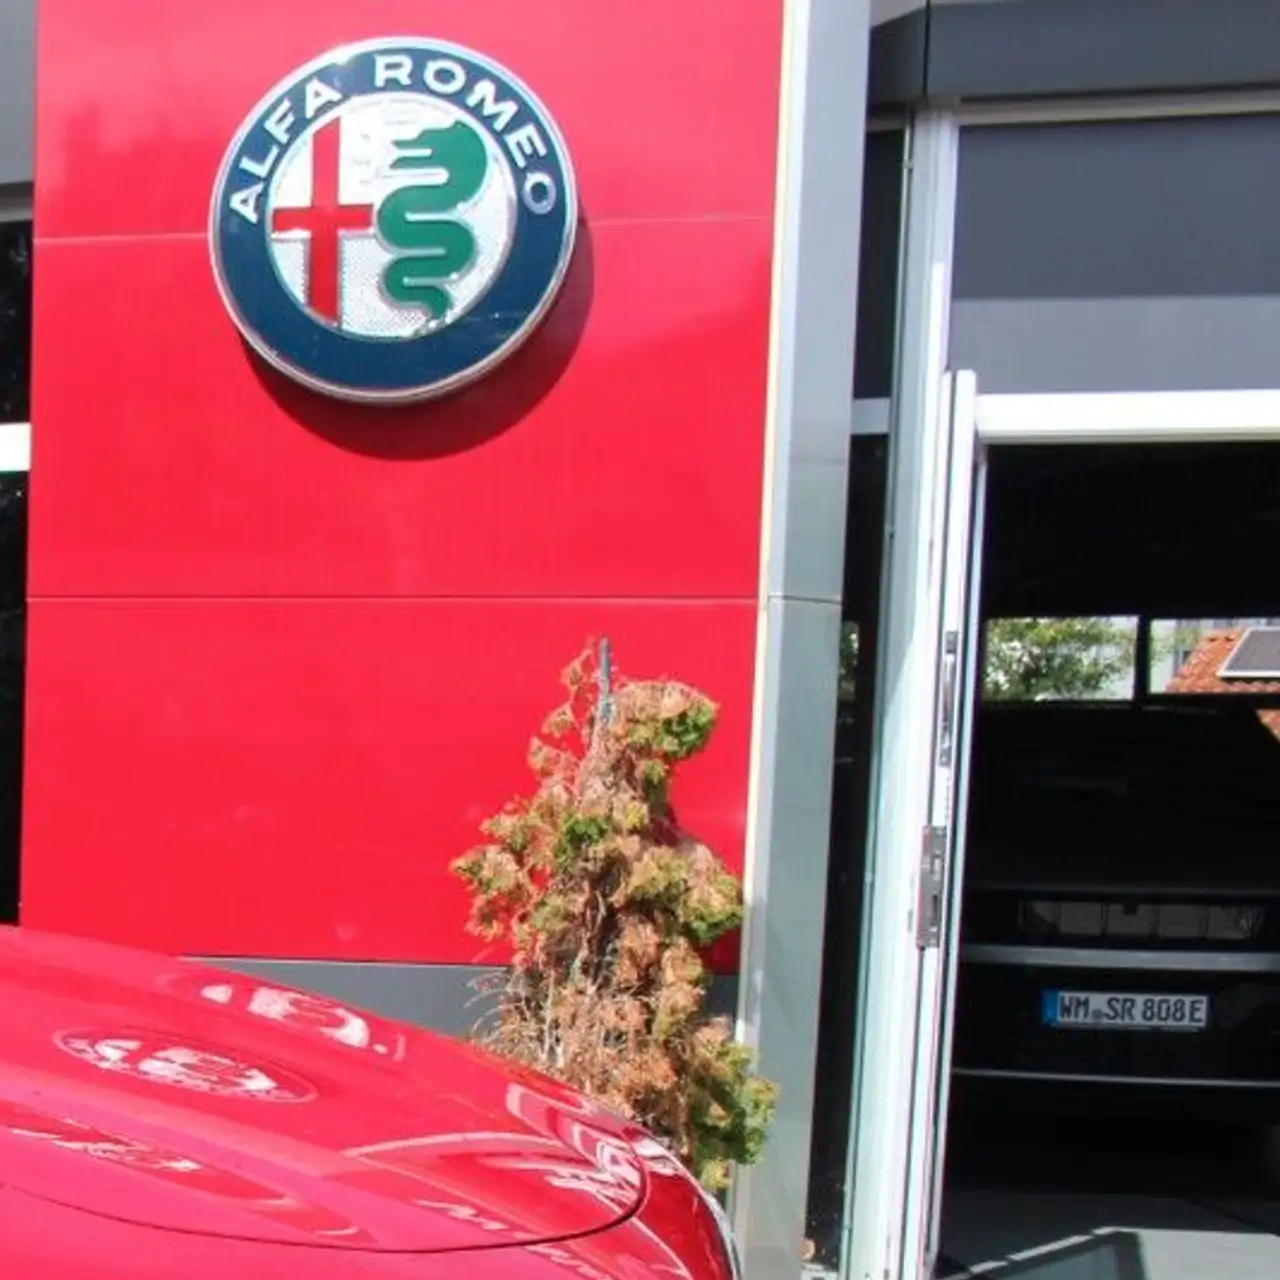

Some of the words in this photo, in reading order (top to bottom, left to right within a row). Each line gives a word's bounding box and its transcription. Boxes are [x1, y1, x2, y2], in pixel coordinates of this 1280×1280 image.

[228, 76, 344, 224] ALFA
[374, 53, 557, 216] ROMEO
[1060, 997, 1090, 1022] WM
[1105, 998, 1136, 1022] SR
[1142, 999, 1204, 1024] 808E
